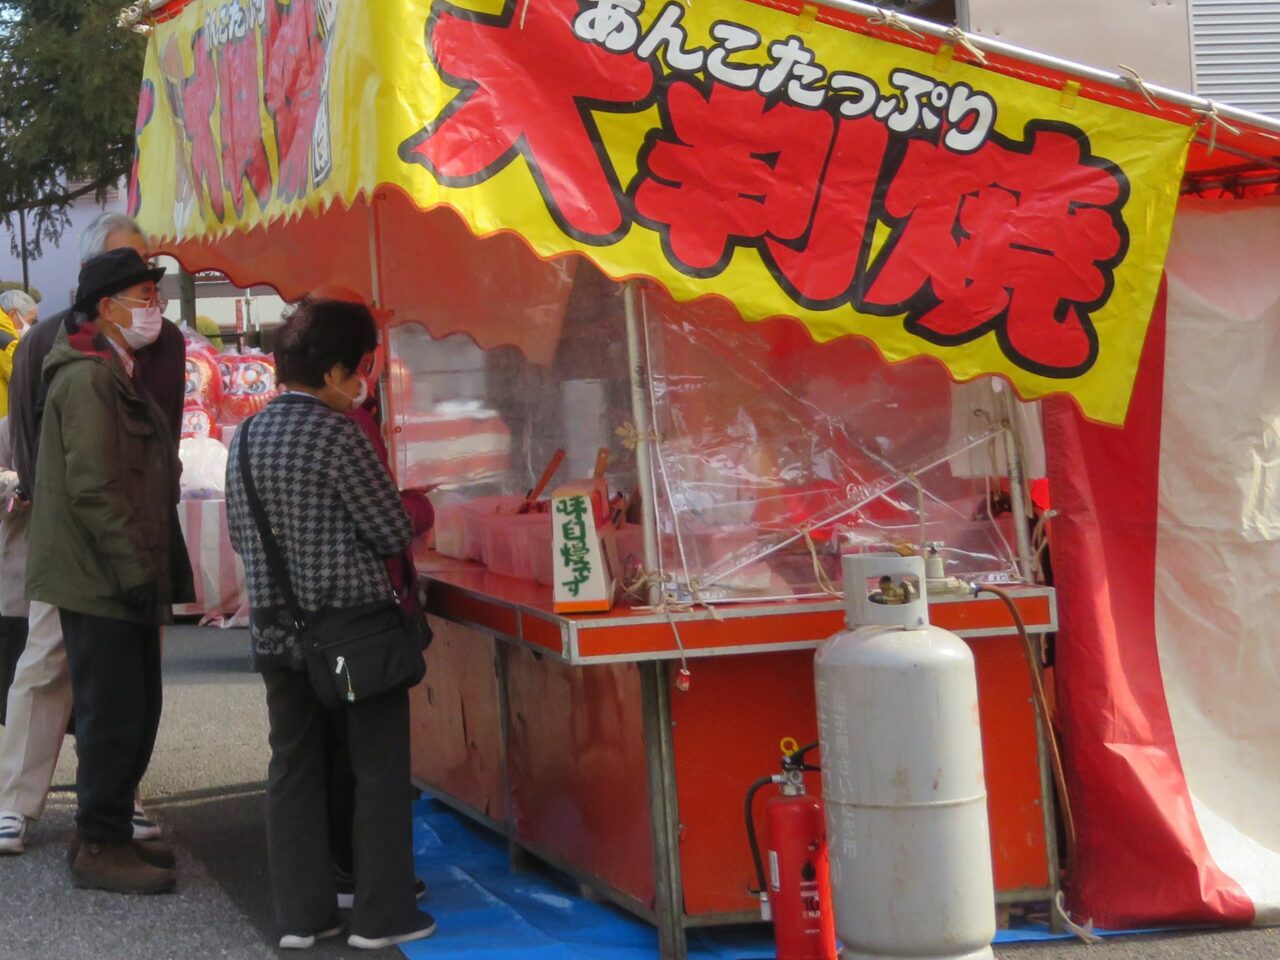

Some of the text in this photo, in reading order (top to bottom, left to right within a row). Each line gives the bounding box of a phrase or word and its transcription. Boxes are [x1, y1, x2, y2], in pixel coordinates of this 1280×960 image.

[556, 495, 592, 597] 味自慢です
